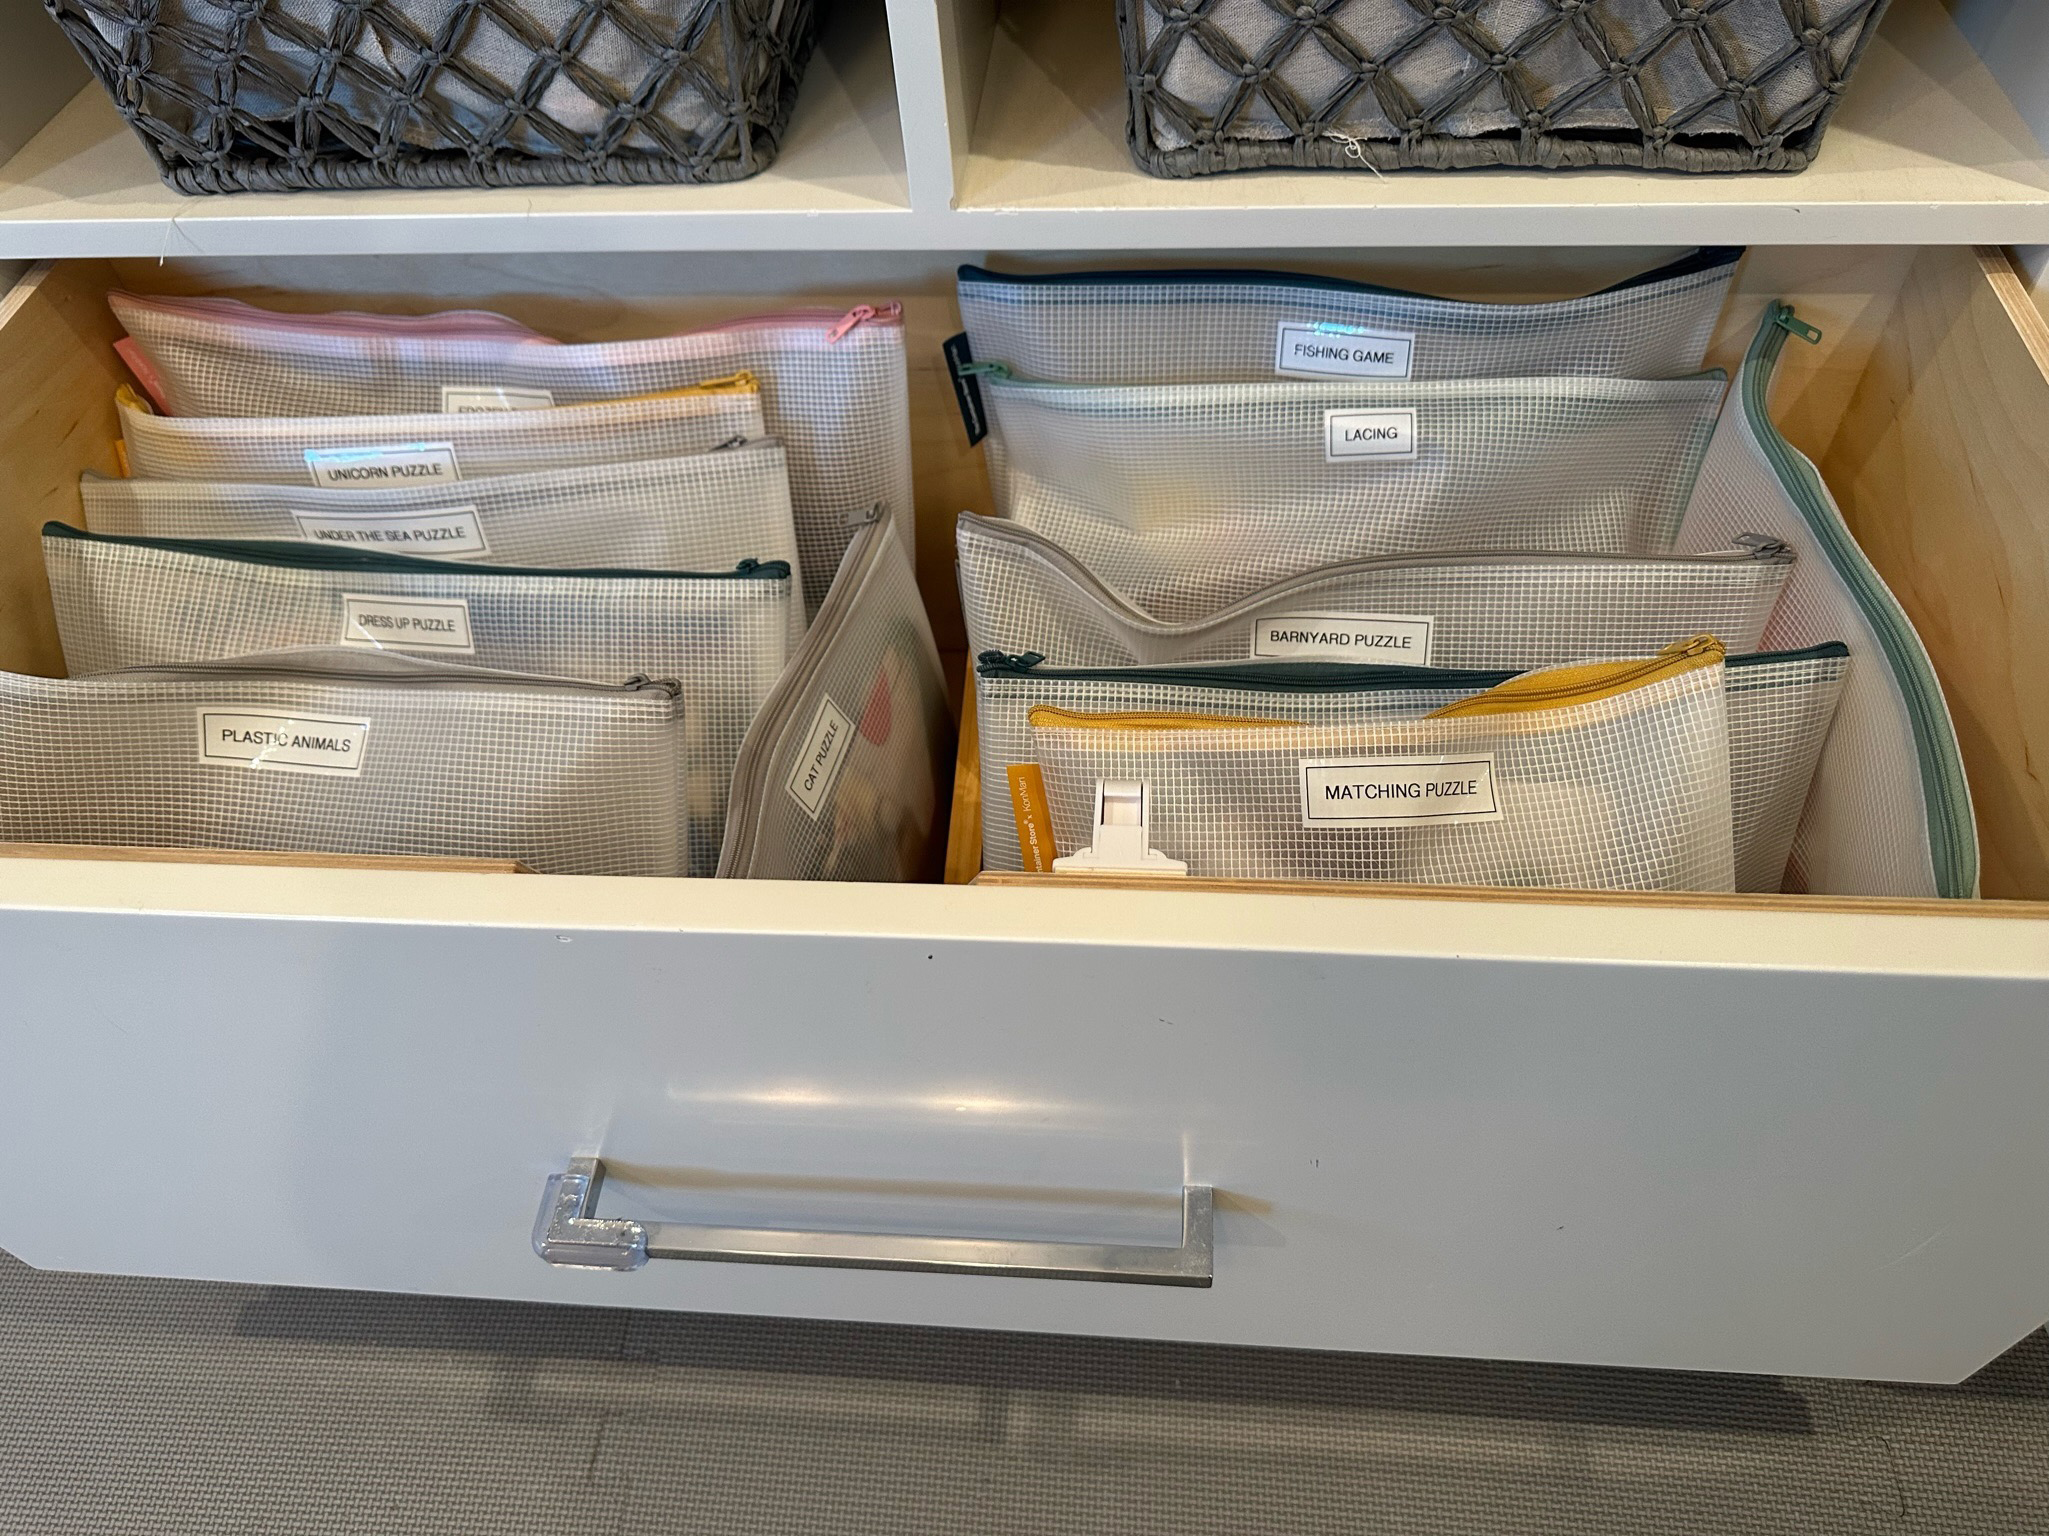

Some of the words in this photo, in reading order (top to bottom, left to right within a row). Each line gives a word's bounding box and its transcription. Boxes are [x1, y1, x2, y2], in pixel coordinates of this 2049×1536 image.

[1294, 343, 1349, 361] FISHING
[1353, 349, 1394, 364] GAME
[1345, 426, 1398, 442] LACING
[327, 465, 389, 482] UNICORN
[391, 462, 443, 478] PUZZLE
[313, 529, 356, 542] UNDER
[356, 530, 383, 542] THE
[384, 528, 411, 542] SEA
[413, 526, 467, 540] PUZZLE
[358, 614, 394, 628] DRESS
[395, 618, 410, 629] UP
[412, 618, 456, 632] PUZZLE
[1269, 630, 1350, 645] BARNYARD
[1354, 634, 1412, 649] PUZZLE
[221, 729, 289, 747] PLASTIC
[292, 735, 352, 753] ANIMALS
[804, 763, 820, 791] CAT
[815, 719, 839, 767] PUZZLE
[1324, 783, 1422, 800] MATCHING
[1425, 779, 1478, 796] PUZZLE
[1032, 846, 1044, 872] ntainer
